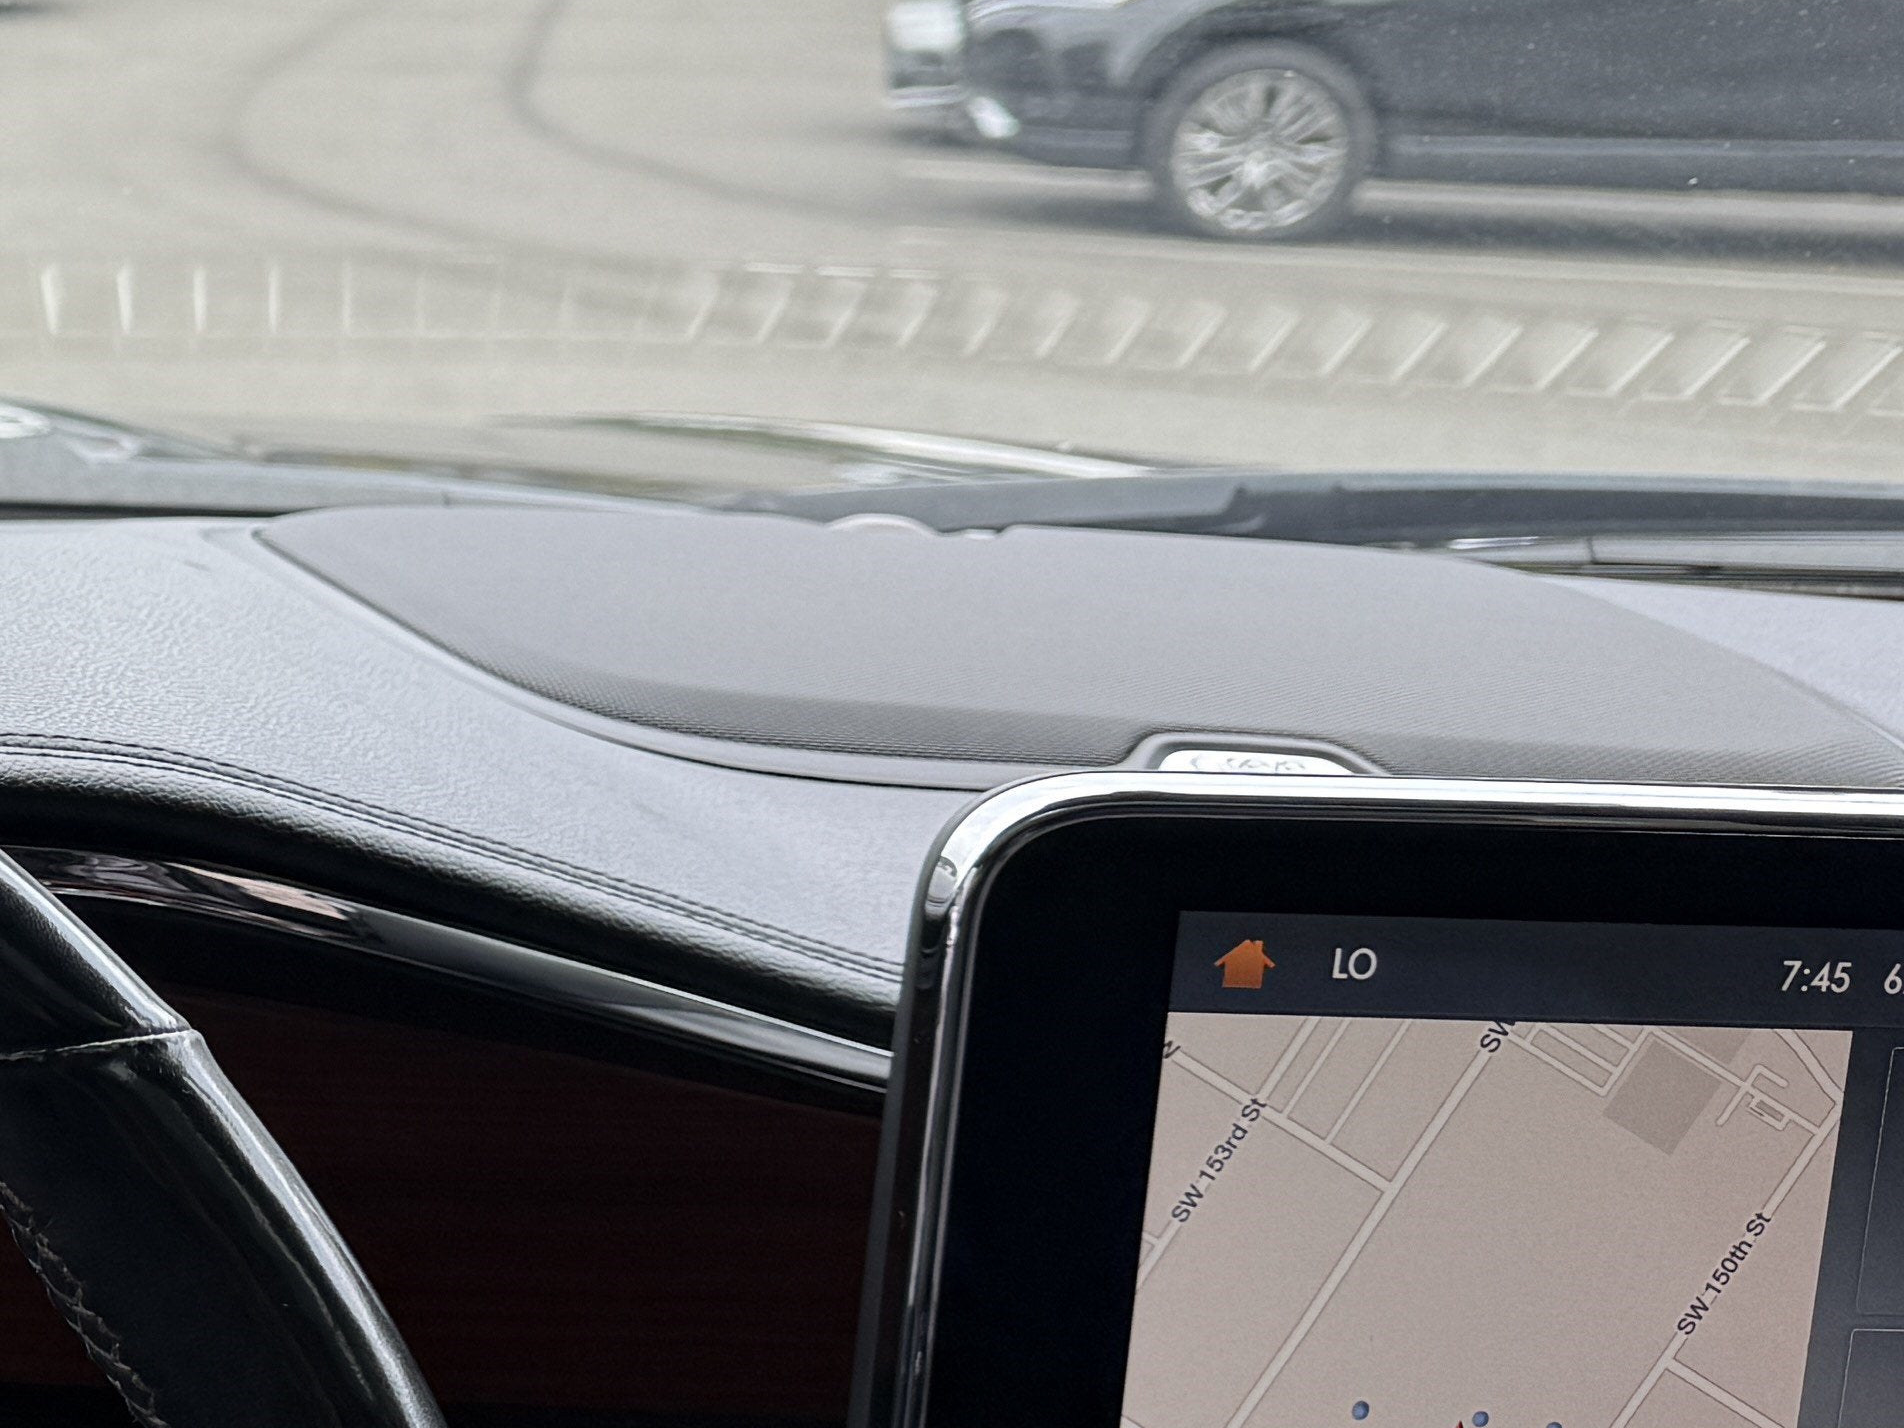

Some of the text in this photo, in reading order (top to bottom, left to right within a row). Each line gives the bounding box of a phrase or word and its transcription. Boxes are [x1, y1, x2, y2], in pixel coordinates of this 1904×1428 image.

[1332, 947, 1904, 995] LO 7:45 6
[1171, 1098, 1267, 1223] SW 153rd St
[1677, 1212, 1772, 1335] SW 150th St
